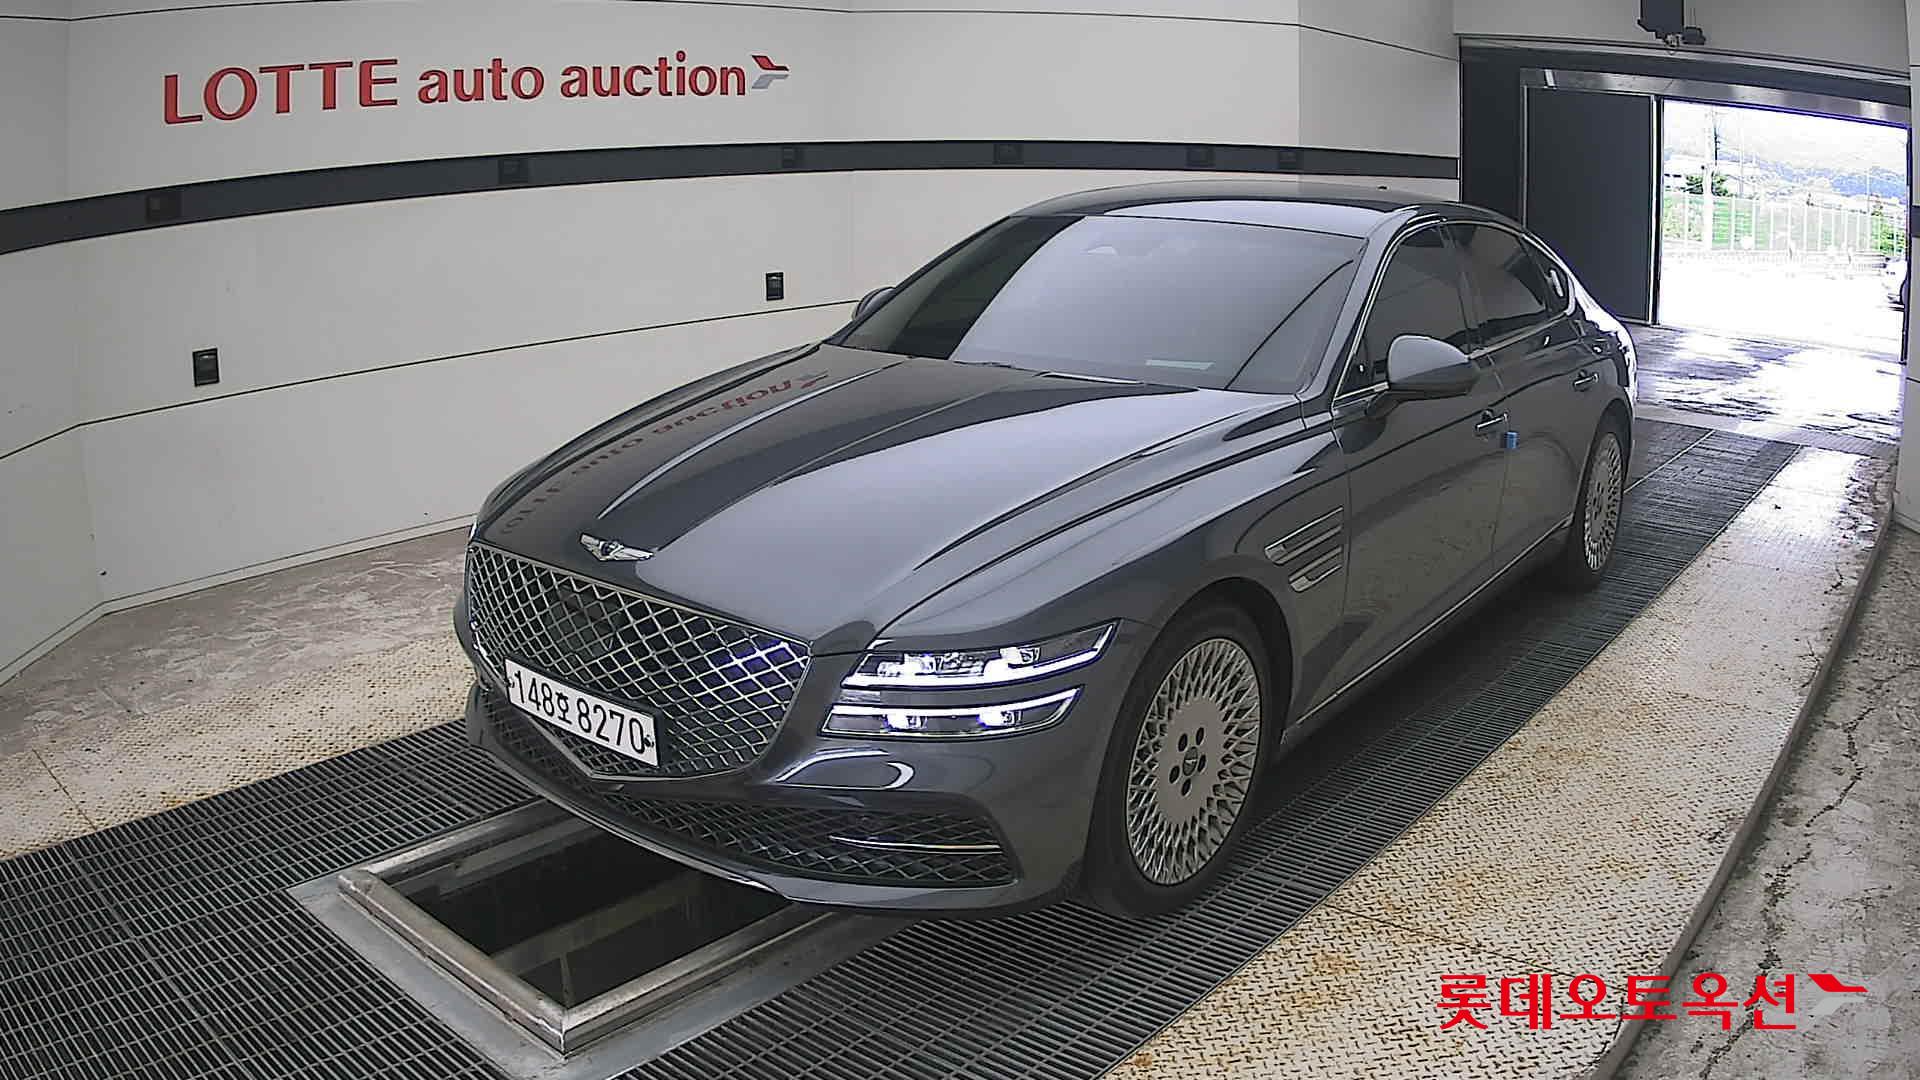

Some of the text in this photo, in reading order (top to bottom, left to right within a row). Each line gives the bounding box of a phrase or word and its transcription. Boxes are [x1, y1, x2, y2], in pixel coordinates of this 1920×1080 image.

[163, 50, 746, 125] LOTTE auto auction
